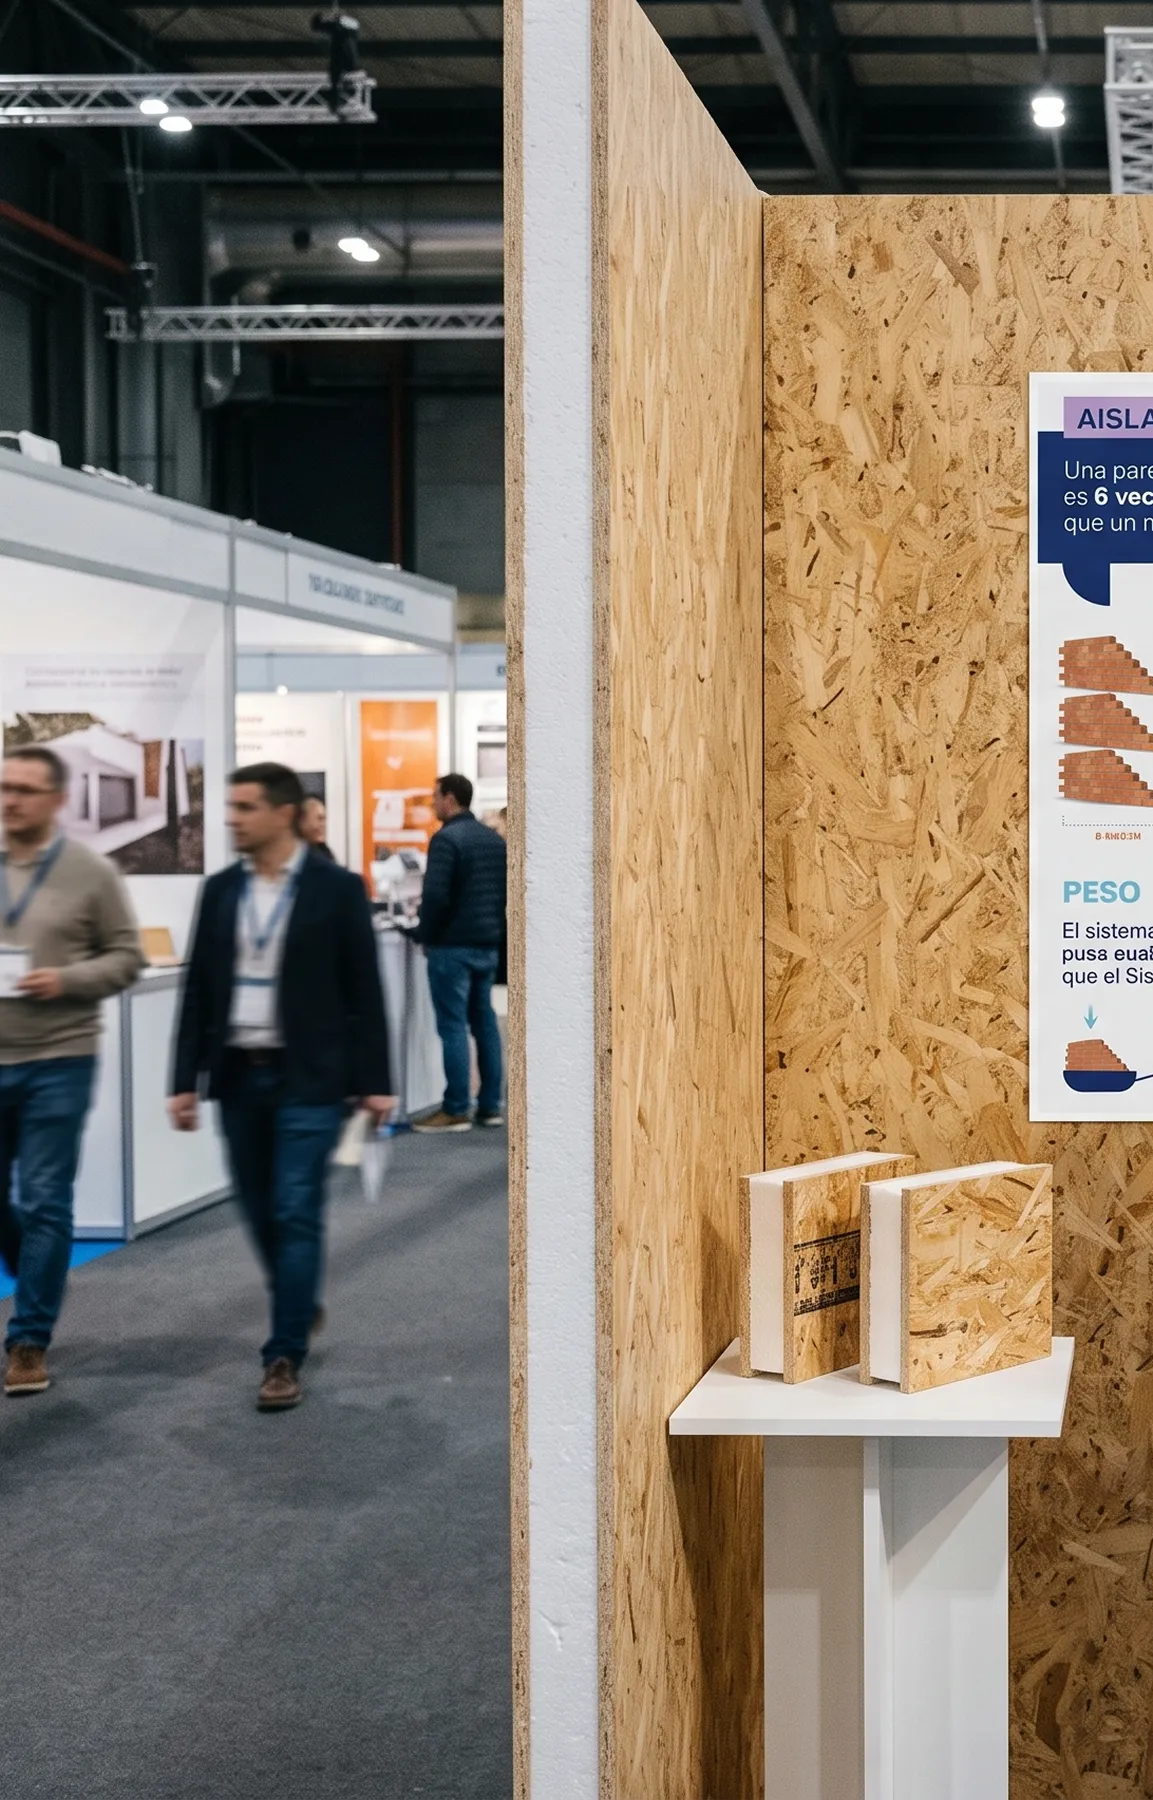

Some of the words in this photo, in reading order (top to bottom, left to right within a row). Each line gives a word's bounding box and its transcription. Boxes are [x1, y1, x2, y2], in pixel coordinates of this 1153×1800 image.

[1065, 460, 1106, 480] Una
[1063, 491, 1088, 506] es
[1094, 486, 1109, 506] 6
[1064, 517, 1104, 536] que
[1110, 517, 1136, 532] un
[1063, 880, 1141, 904] PESO
[1063, 921, 1079, 939] El
[1062, 971, 1098, 989] que
[1103, 967, 1120, 984] el
